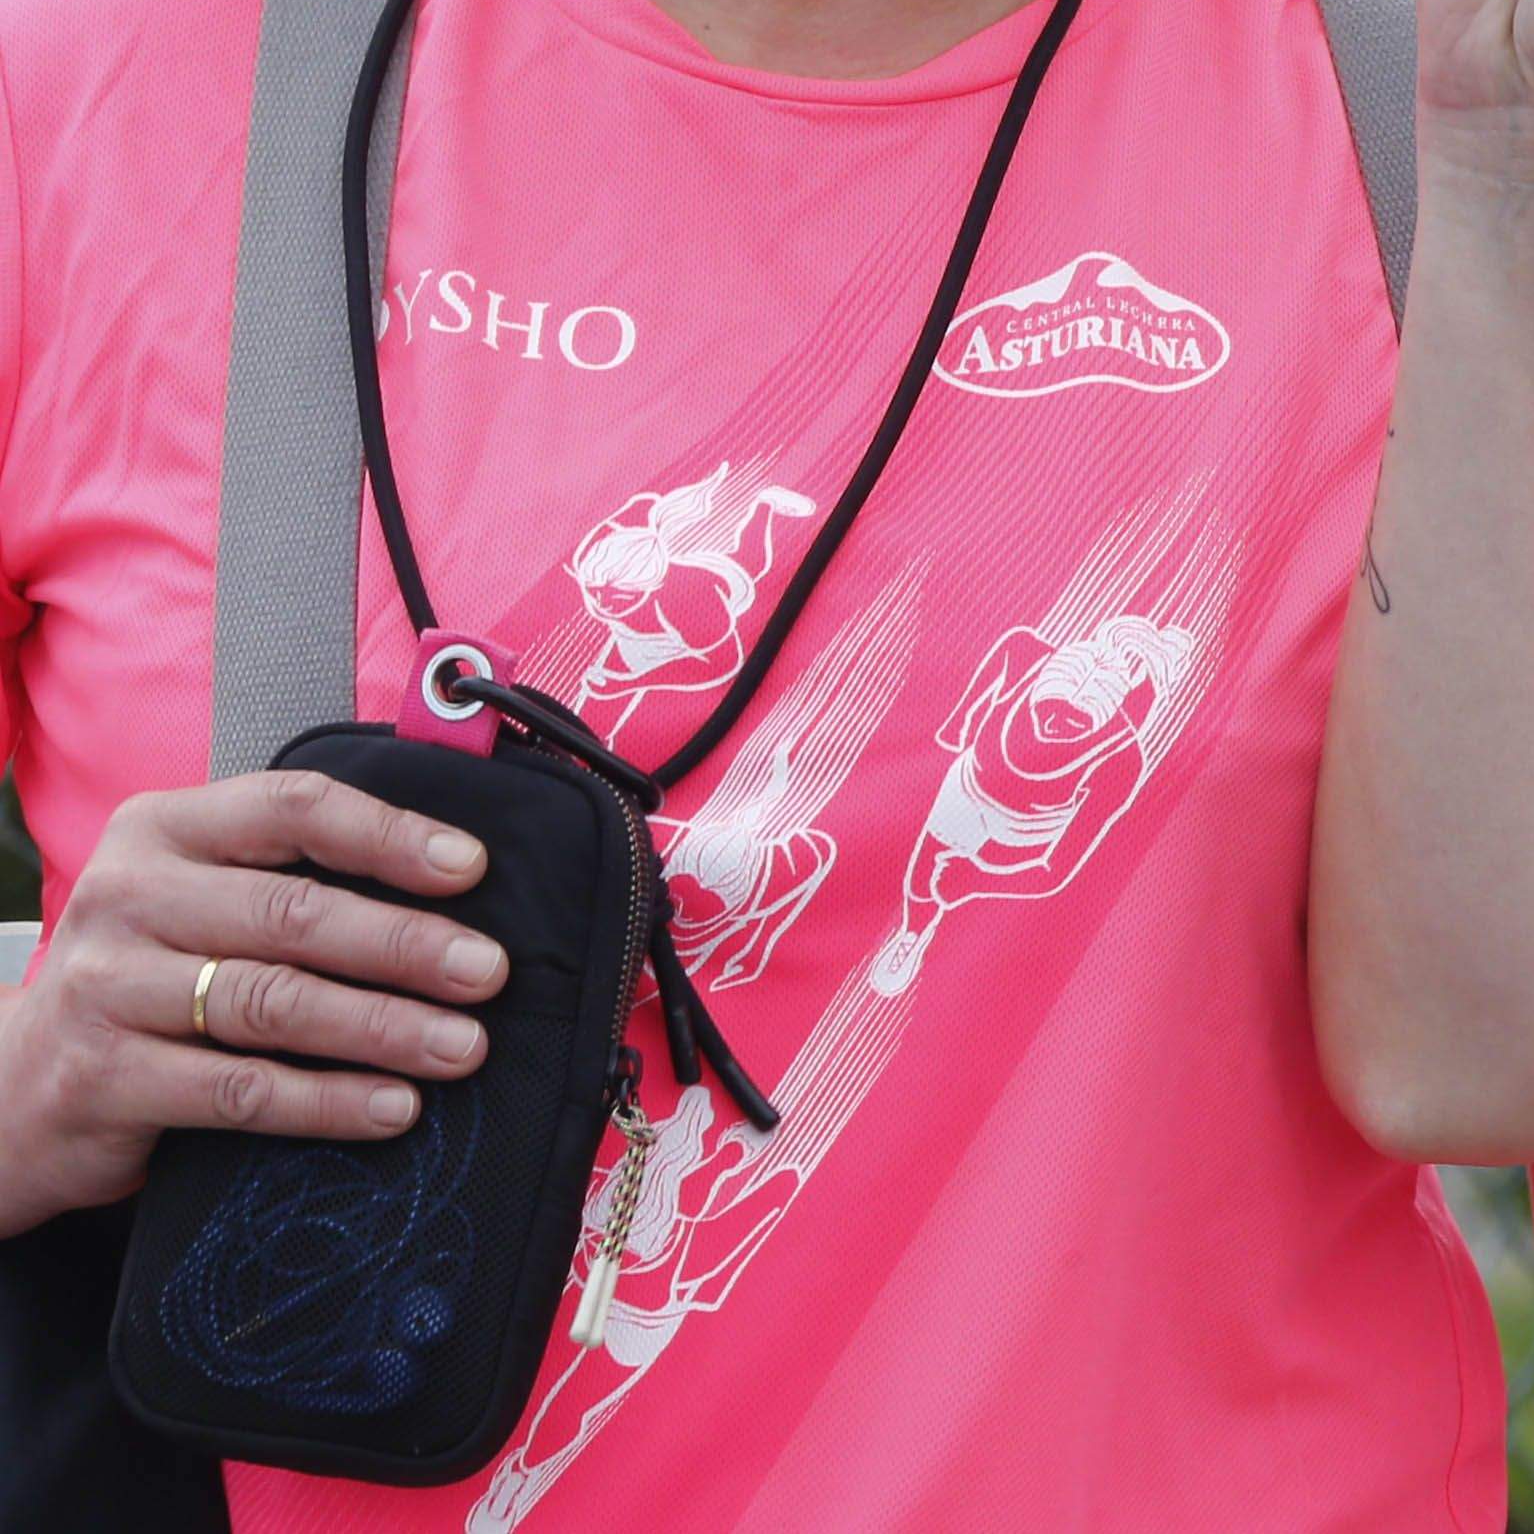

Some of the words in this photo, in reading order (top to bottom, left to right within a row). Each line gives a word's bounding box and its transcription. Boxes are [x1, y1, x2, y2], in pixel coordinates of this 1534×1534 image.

[377, 268, 637, 371] YSHO
[1006, 296, 1096, 334] CENTRAL
[1105, 295, 1197, 332] LECHERA
[953, 315, 1207, 375] ASTURIANA
